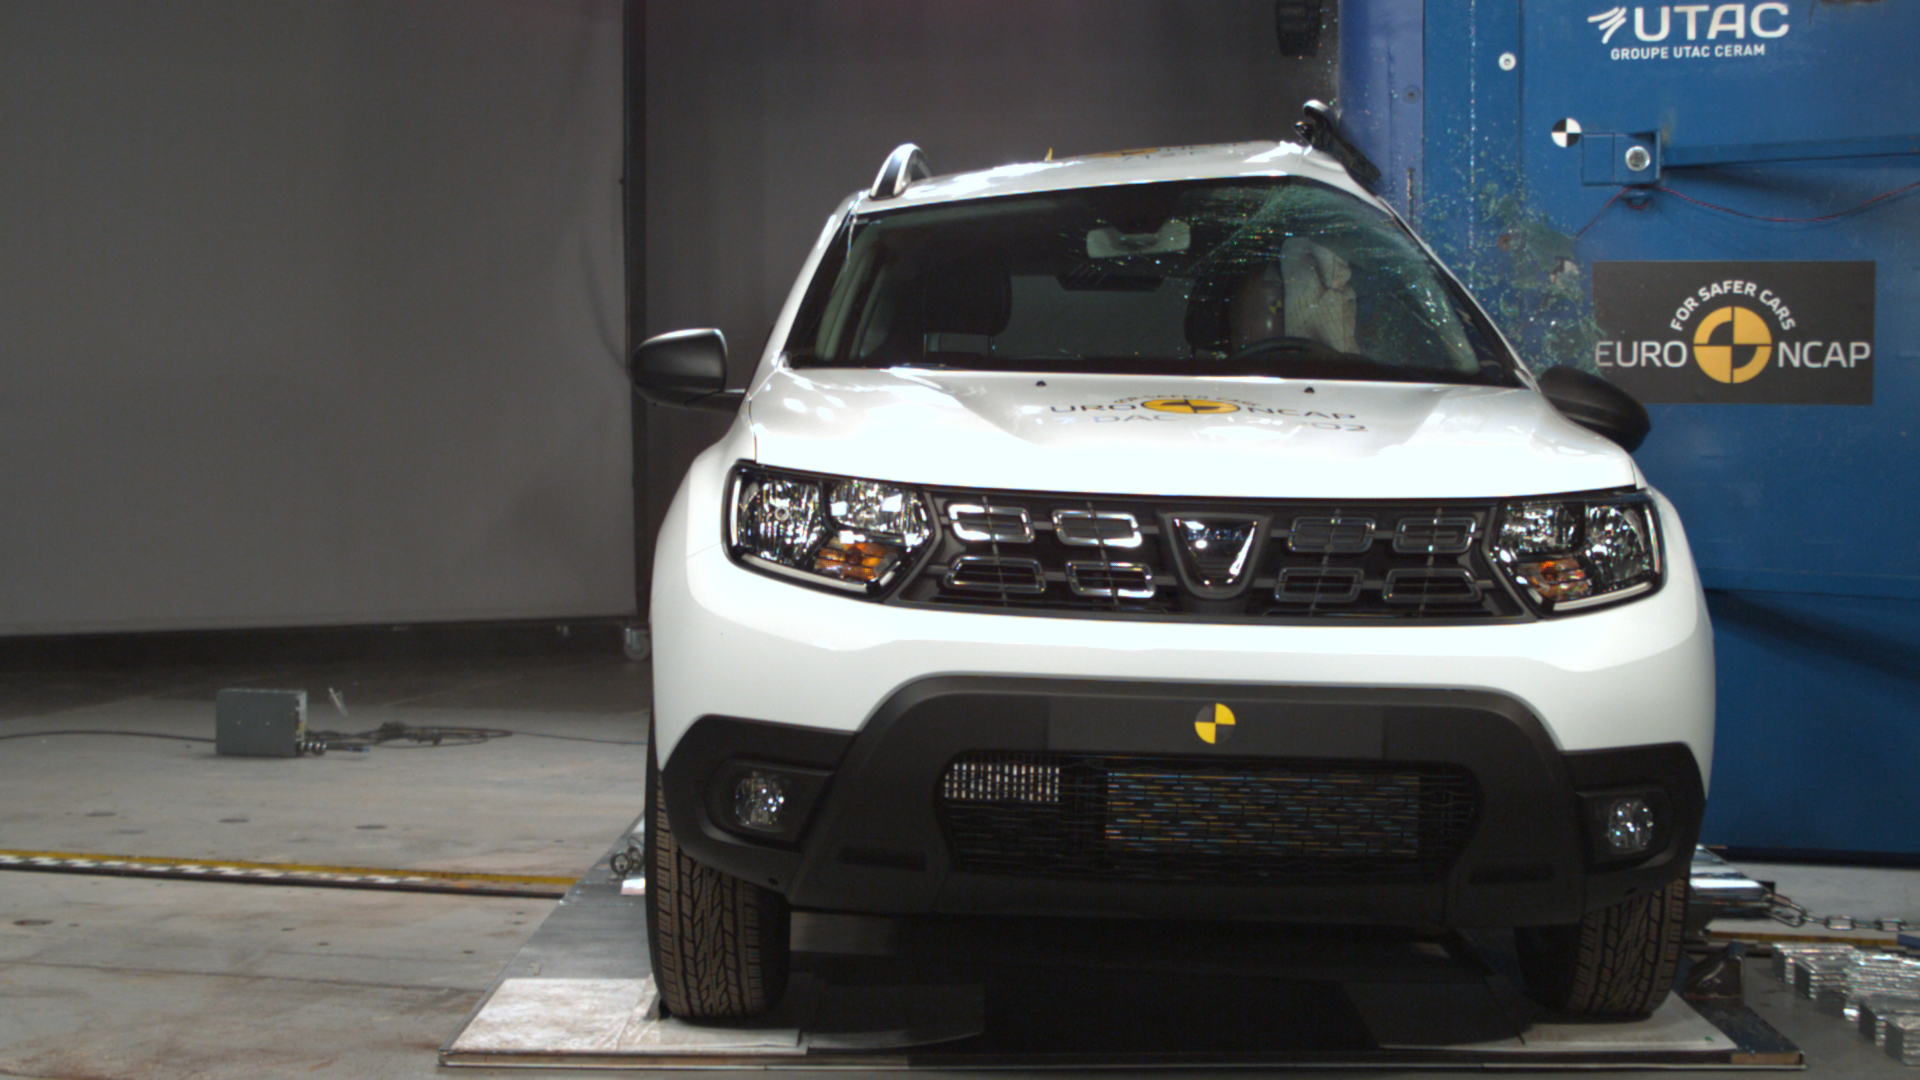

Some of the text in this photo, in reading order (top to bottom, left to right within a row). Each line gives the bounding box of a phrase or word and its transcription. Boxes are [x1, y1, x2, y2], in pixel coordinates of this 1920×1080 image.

[1634, 2, 1790, 42] UTAC
[1610, 44, 1766, 60] GROUPE UTAC CERAM
[1670, 280, 1796, 331] FOR SAFER CARS
[1595, 341, 1871, 368] EURO NCAP
[1050, 404, 1357, 420] URO NCAP
